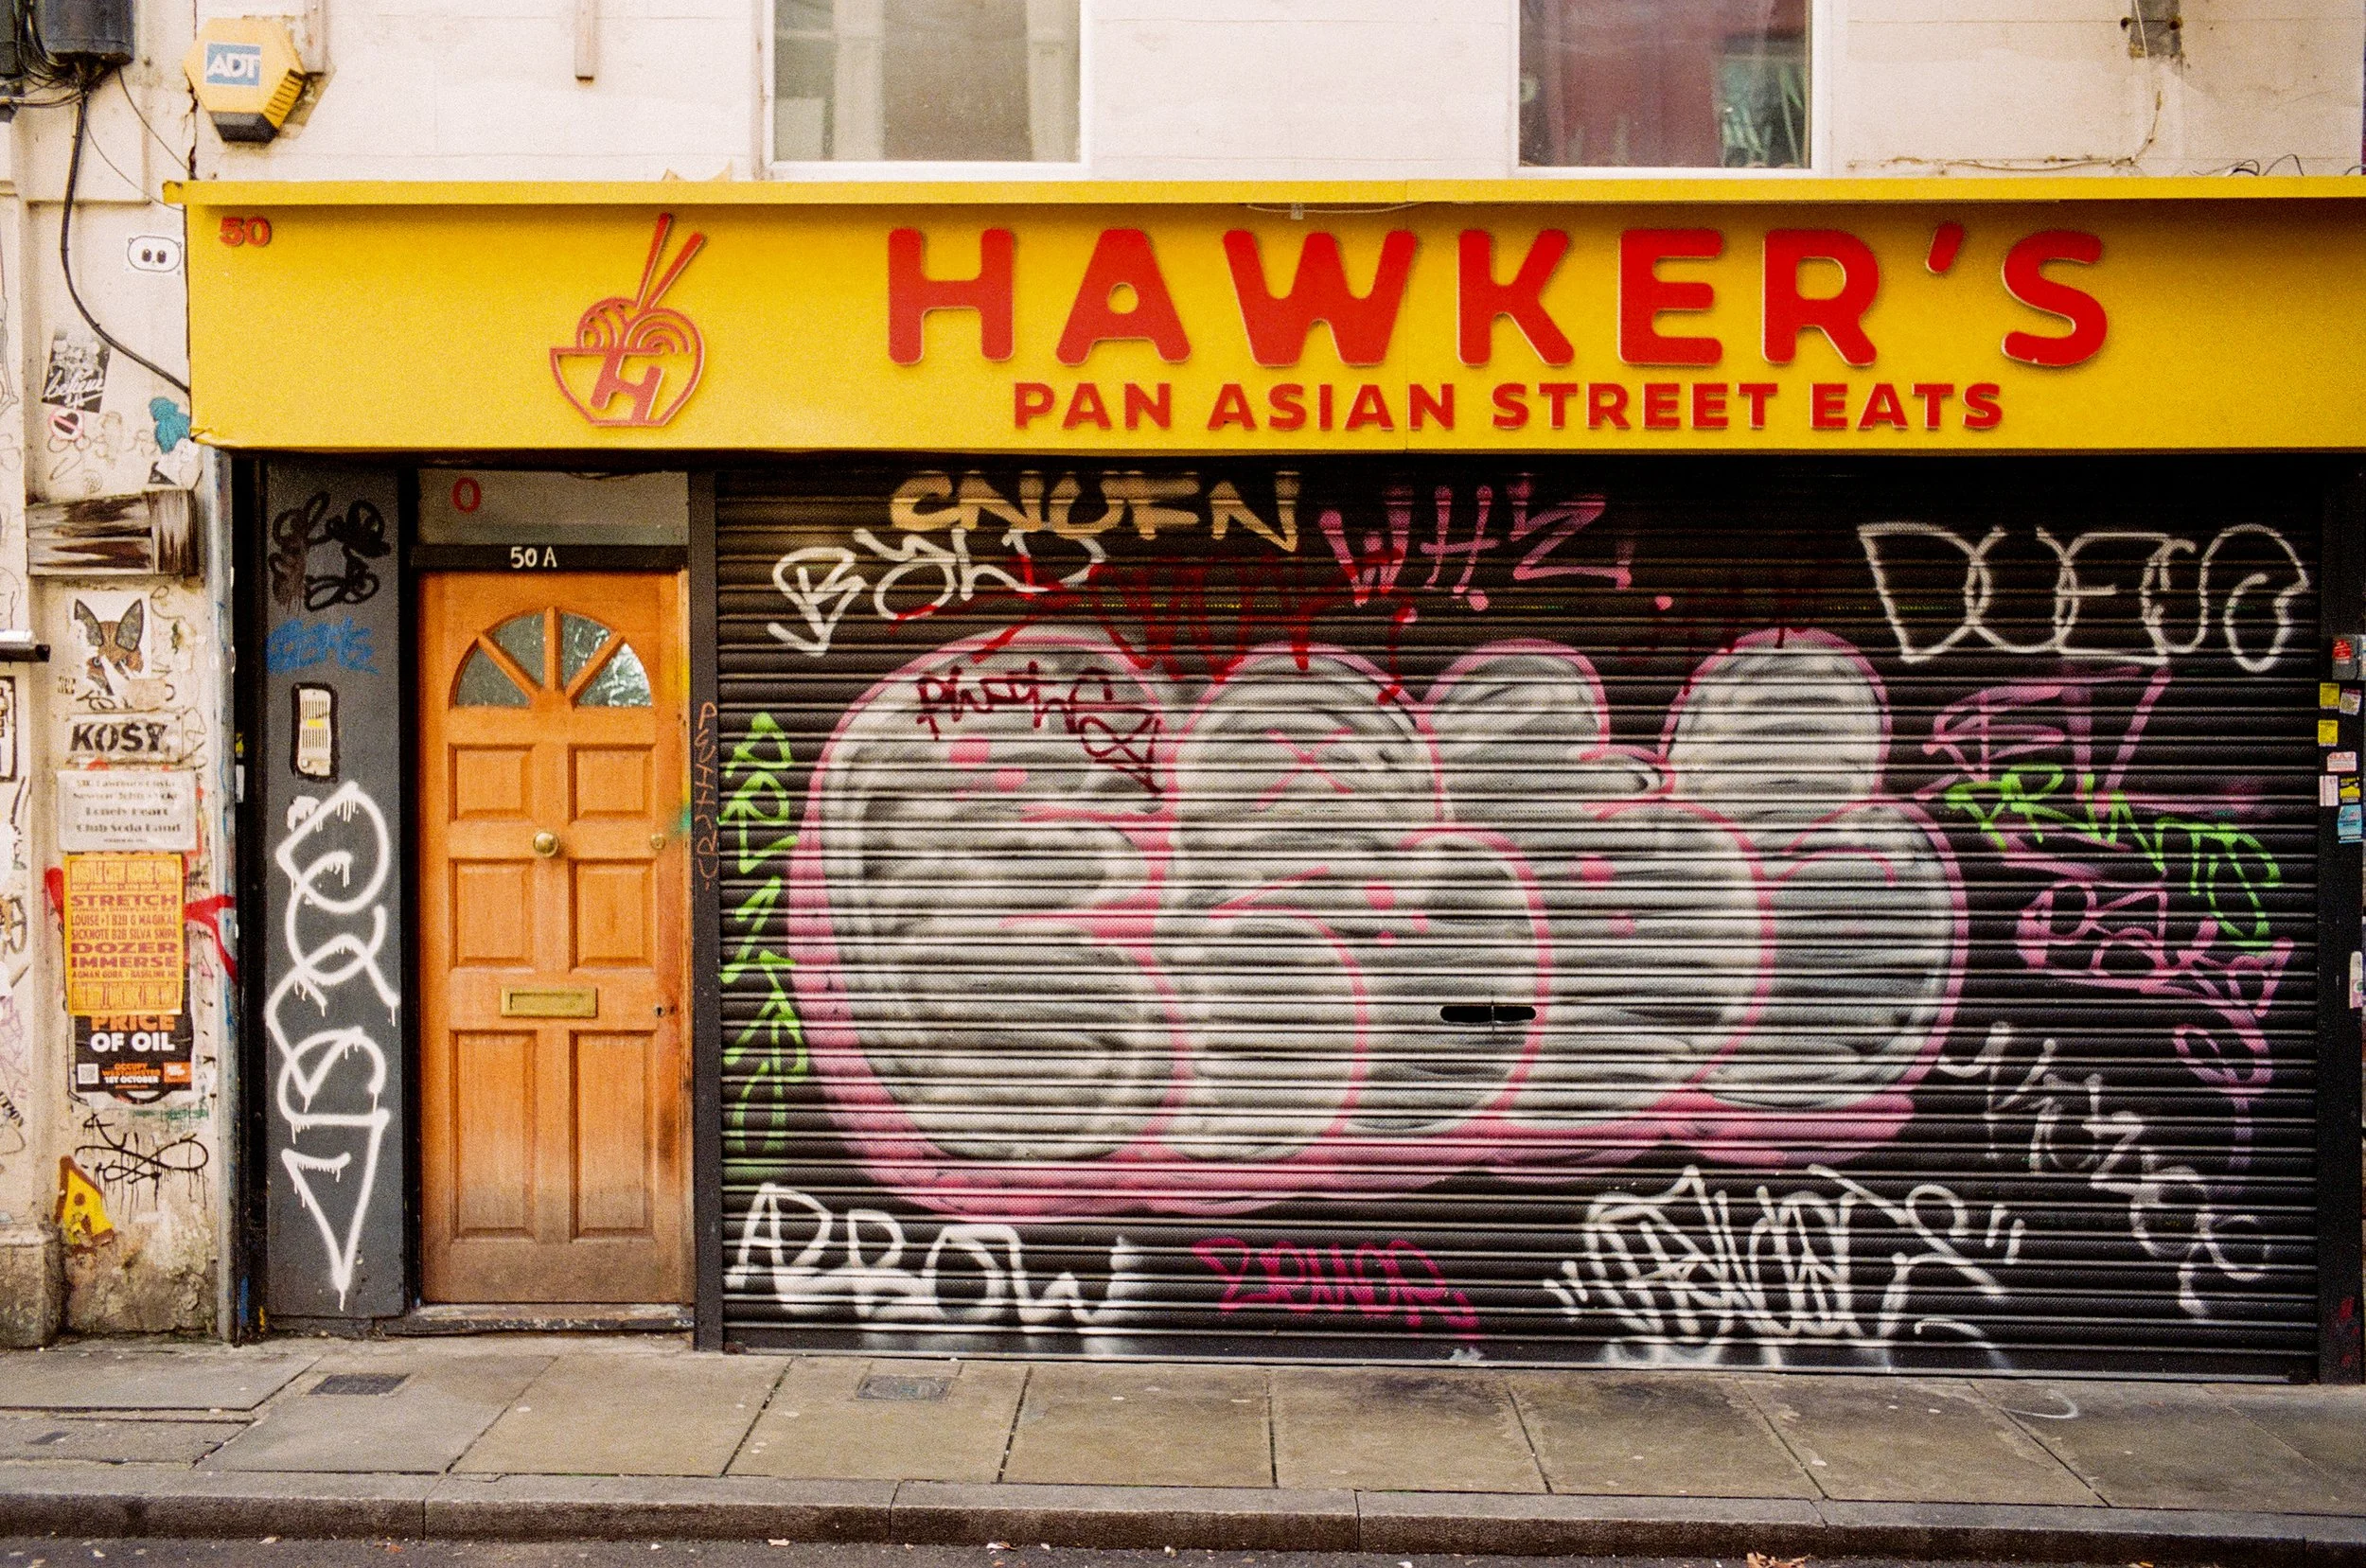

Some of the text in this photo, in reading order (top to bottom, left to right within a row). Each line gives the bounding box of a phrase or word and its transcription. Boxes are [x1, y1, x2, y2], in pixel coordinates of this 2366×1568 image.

[207, 51, 261, 79] ADT
[220, 217, 272, 246] 50
[886, 222, 2110, 369] HAWKER'S
[1014, 381, 2003, 432] PAN ASIAN STREET EATS
[69, 722, 168, 752] KOSY
[71, 894, 178, 907] STRETCH
[71, 942, 178, 954] DOZER
[71, 956, 178, 968] IMMERSE
[91, 1014, 175, 1031] PRICE
[90, 1031, 176, 1052] OF OIL
